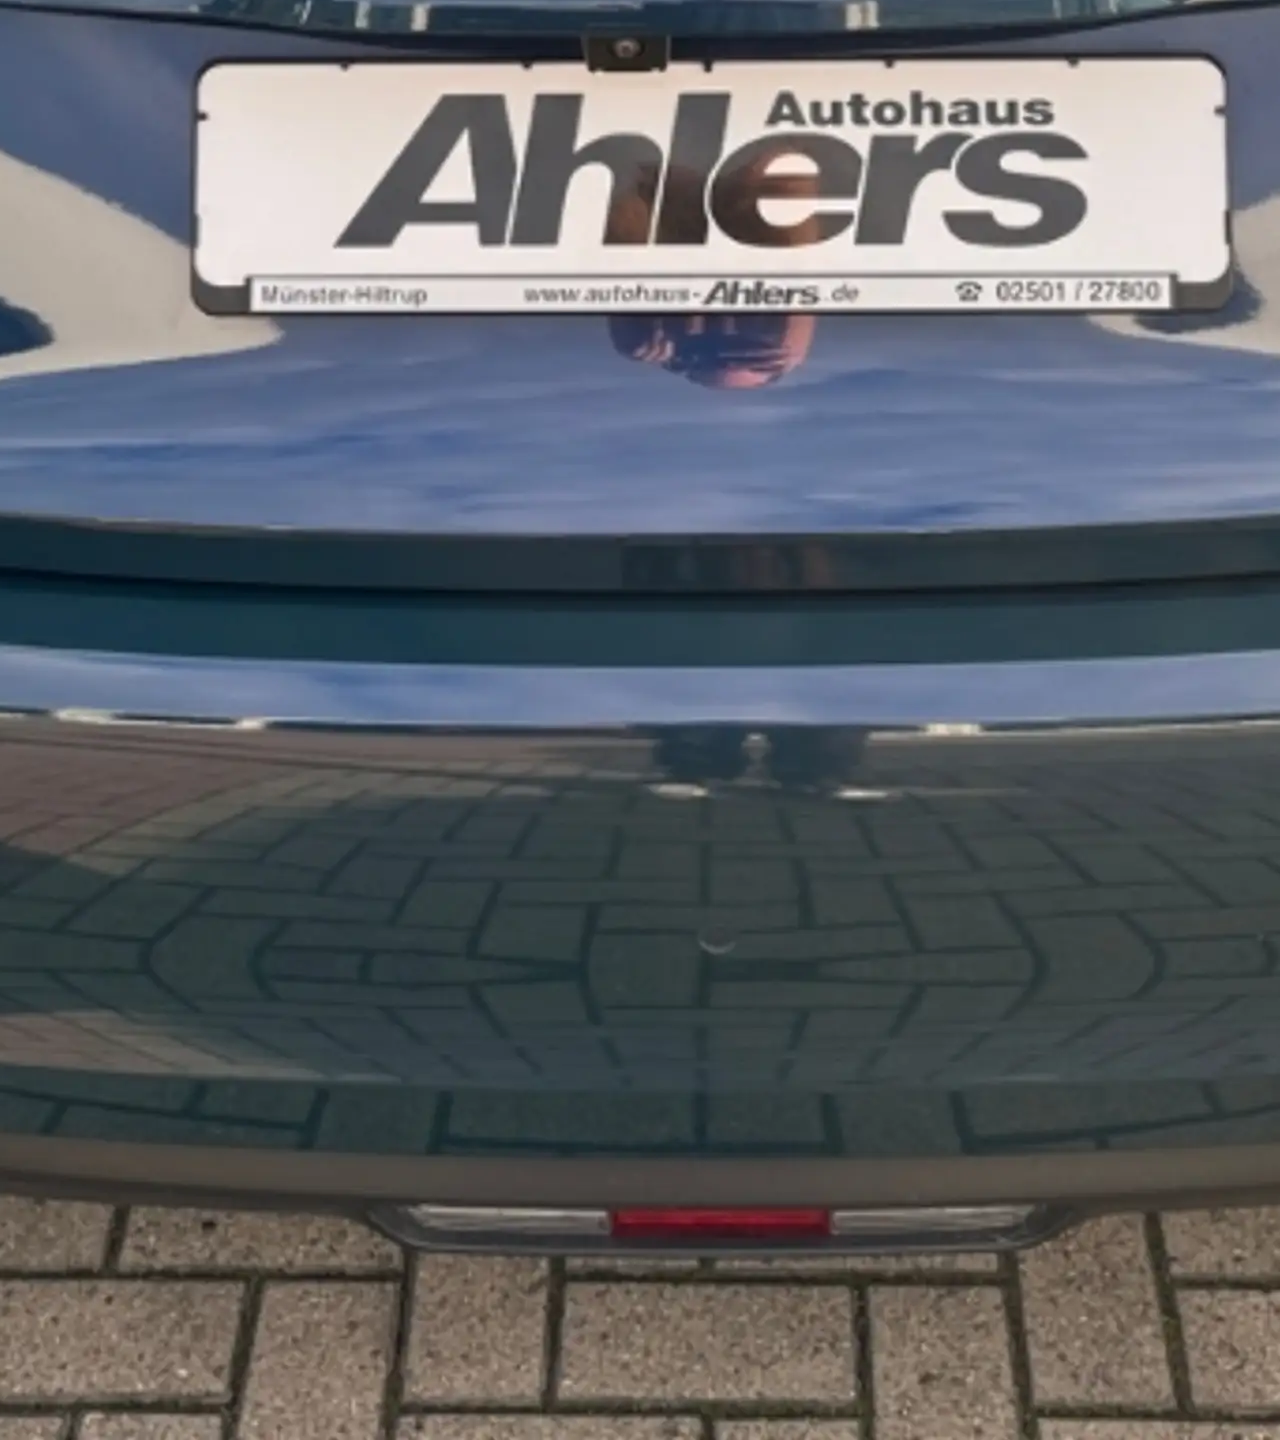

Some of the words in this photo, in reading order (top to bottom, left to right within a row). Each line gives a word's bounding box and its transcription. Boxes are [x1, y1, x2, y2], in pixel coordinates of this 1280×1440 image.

[765, 90, 1056, 127] Autohaus
[333, 91, 1090, 250] Ahlers
[261, 283, 428, 306] Münster-Hiltrup
[995, 279, 1067, 303] 02501
[1090, 279, 1162, 303] 27800
